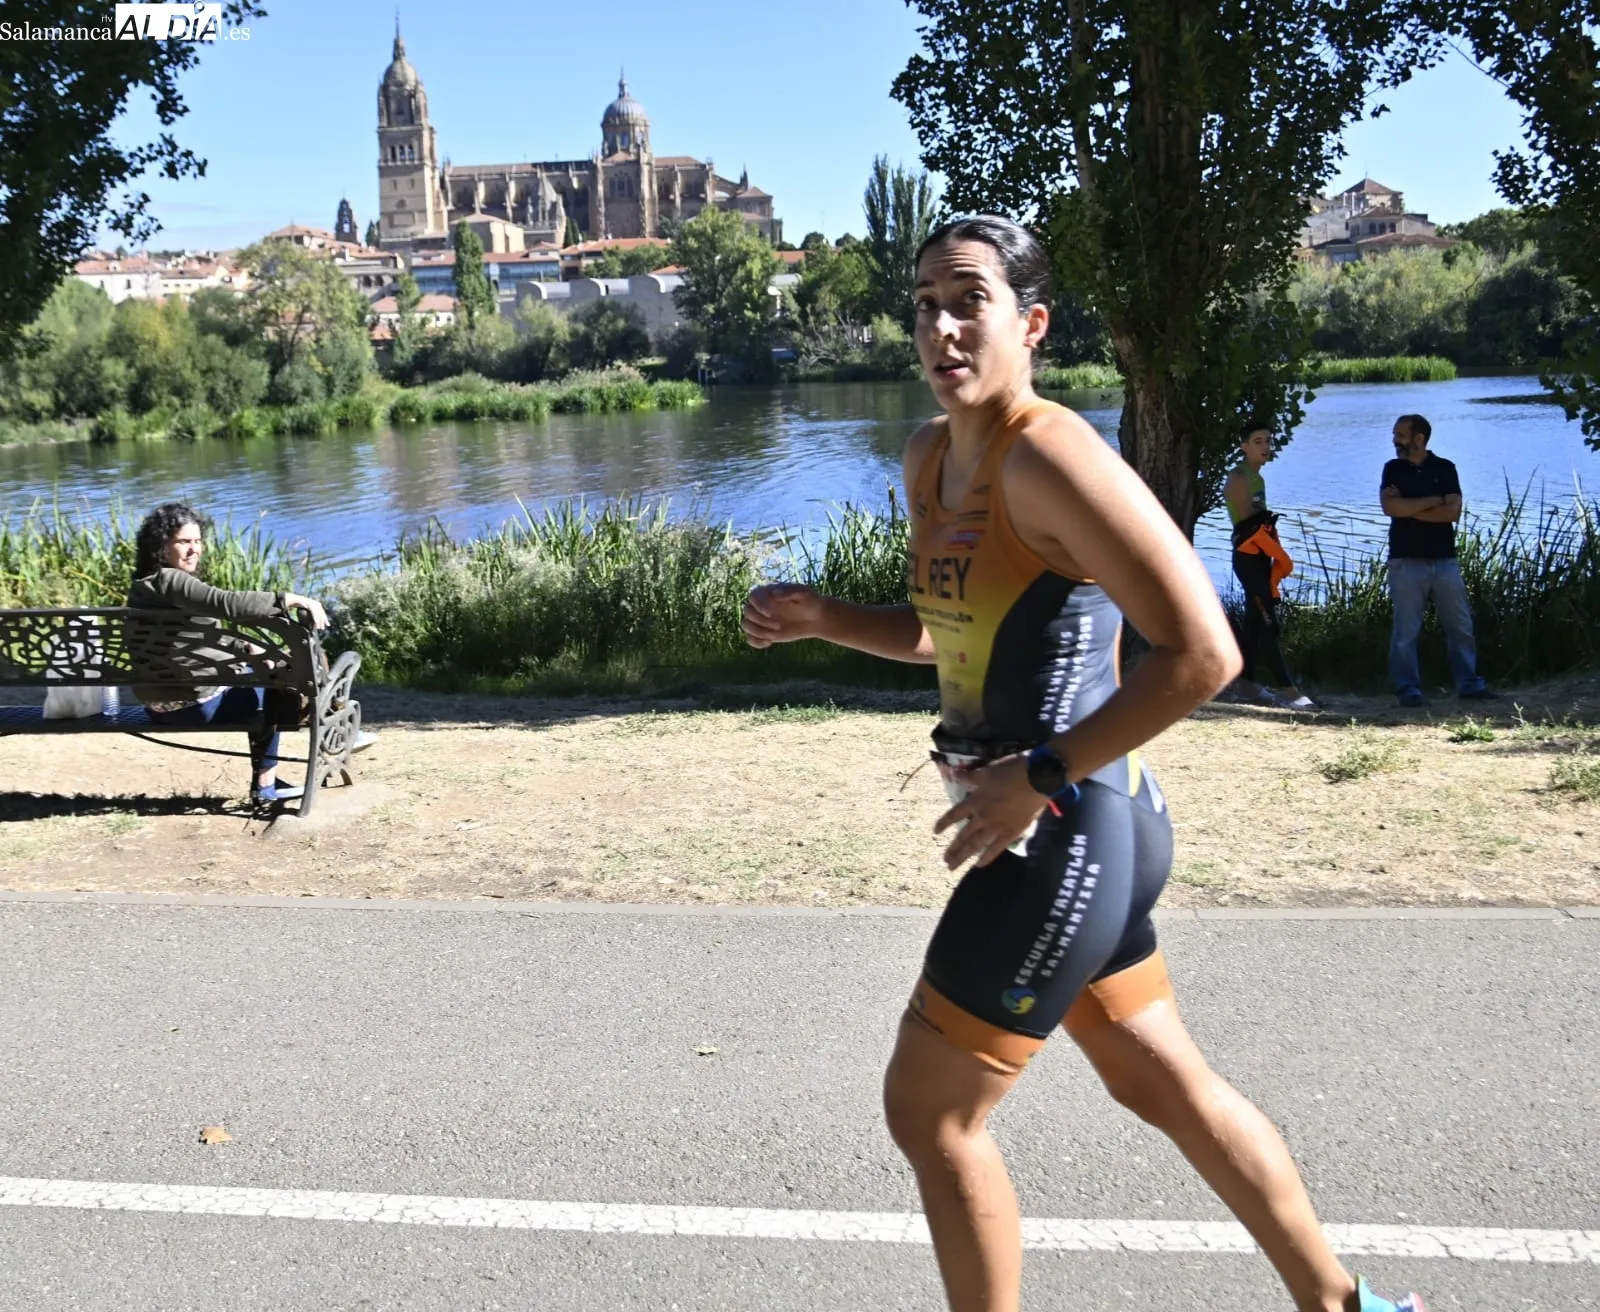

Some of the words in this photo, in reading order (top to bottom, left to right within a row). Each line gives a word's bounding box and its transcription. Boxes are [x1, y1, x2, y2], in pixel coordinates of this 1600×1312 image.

[928, 556, 972, 601] REY
[1041, 862, 1101, 978] SALMANTINA
[1013, 922, 1058, 986] ESCUELA
